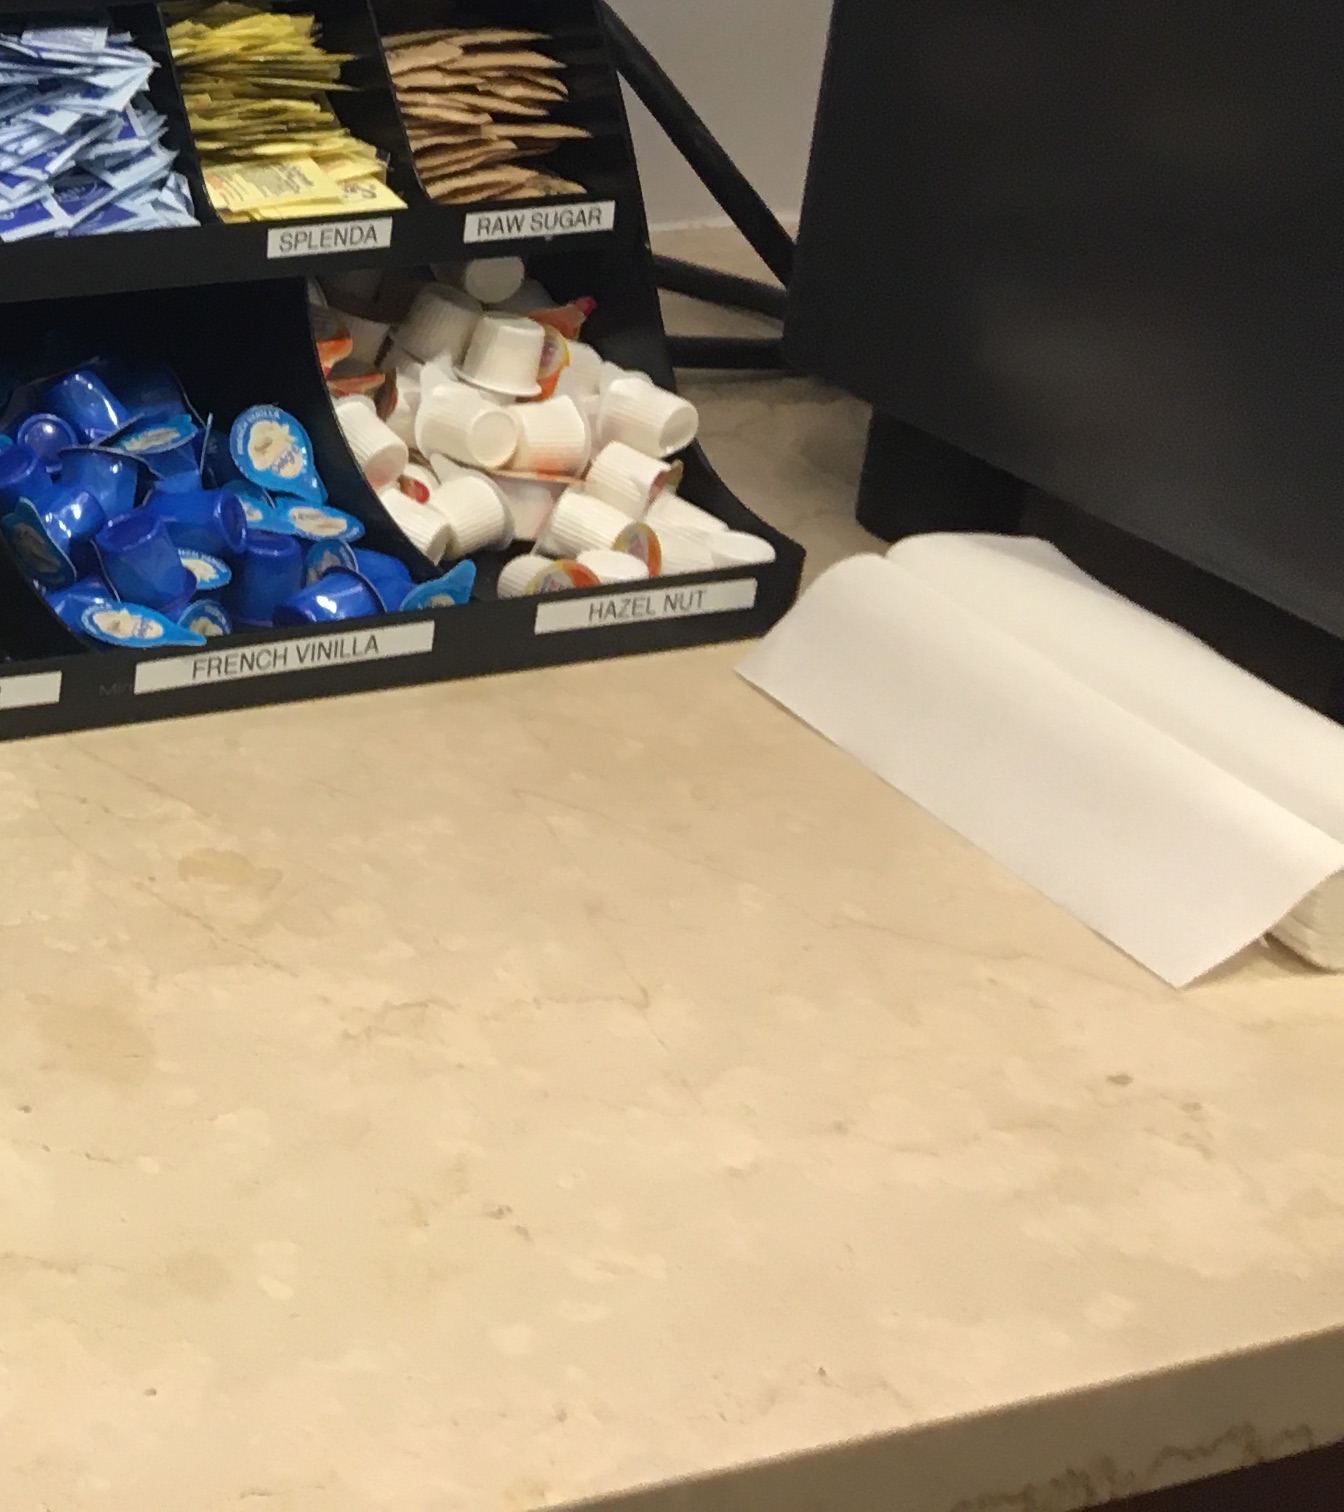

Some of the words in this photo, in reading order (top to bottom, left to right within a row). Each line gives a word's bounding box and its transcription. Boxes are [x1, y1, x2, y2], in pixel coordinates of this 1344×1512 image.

[476, 213, 525, 237] RAW
[529, 206, 602, 233] SUGAR
[278, 223, 378, 254] SPLENDA
[588, 597, 656, 622] HAZEL
[663, 589, 708, 612] NUT
[191, 648, 288, 680] FRENCH
[296, 634, 379, 664] VINILLA
